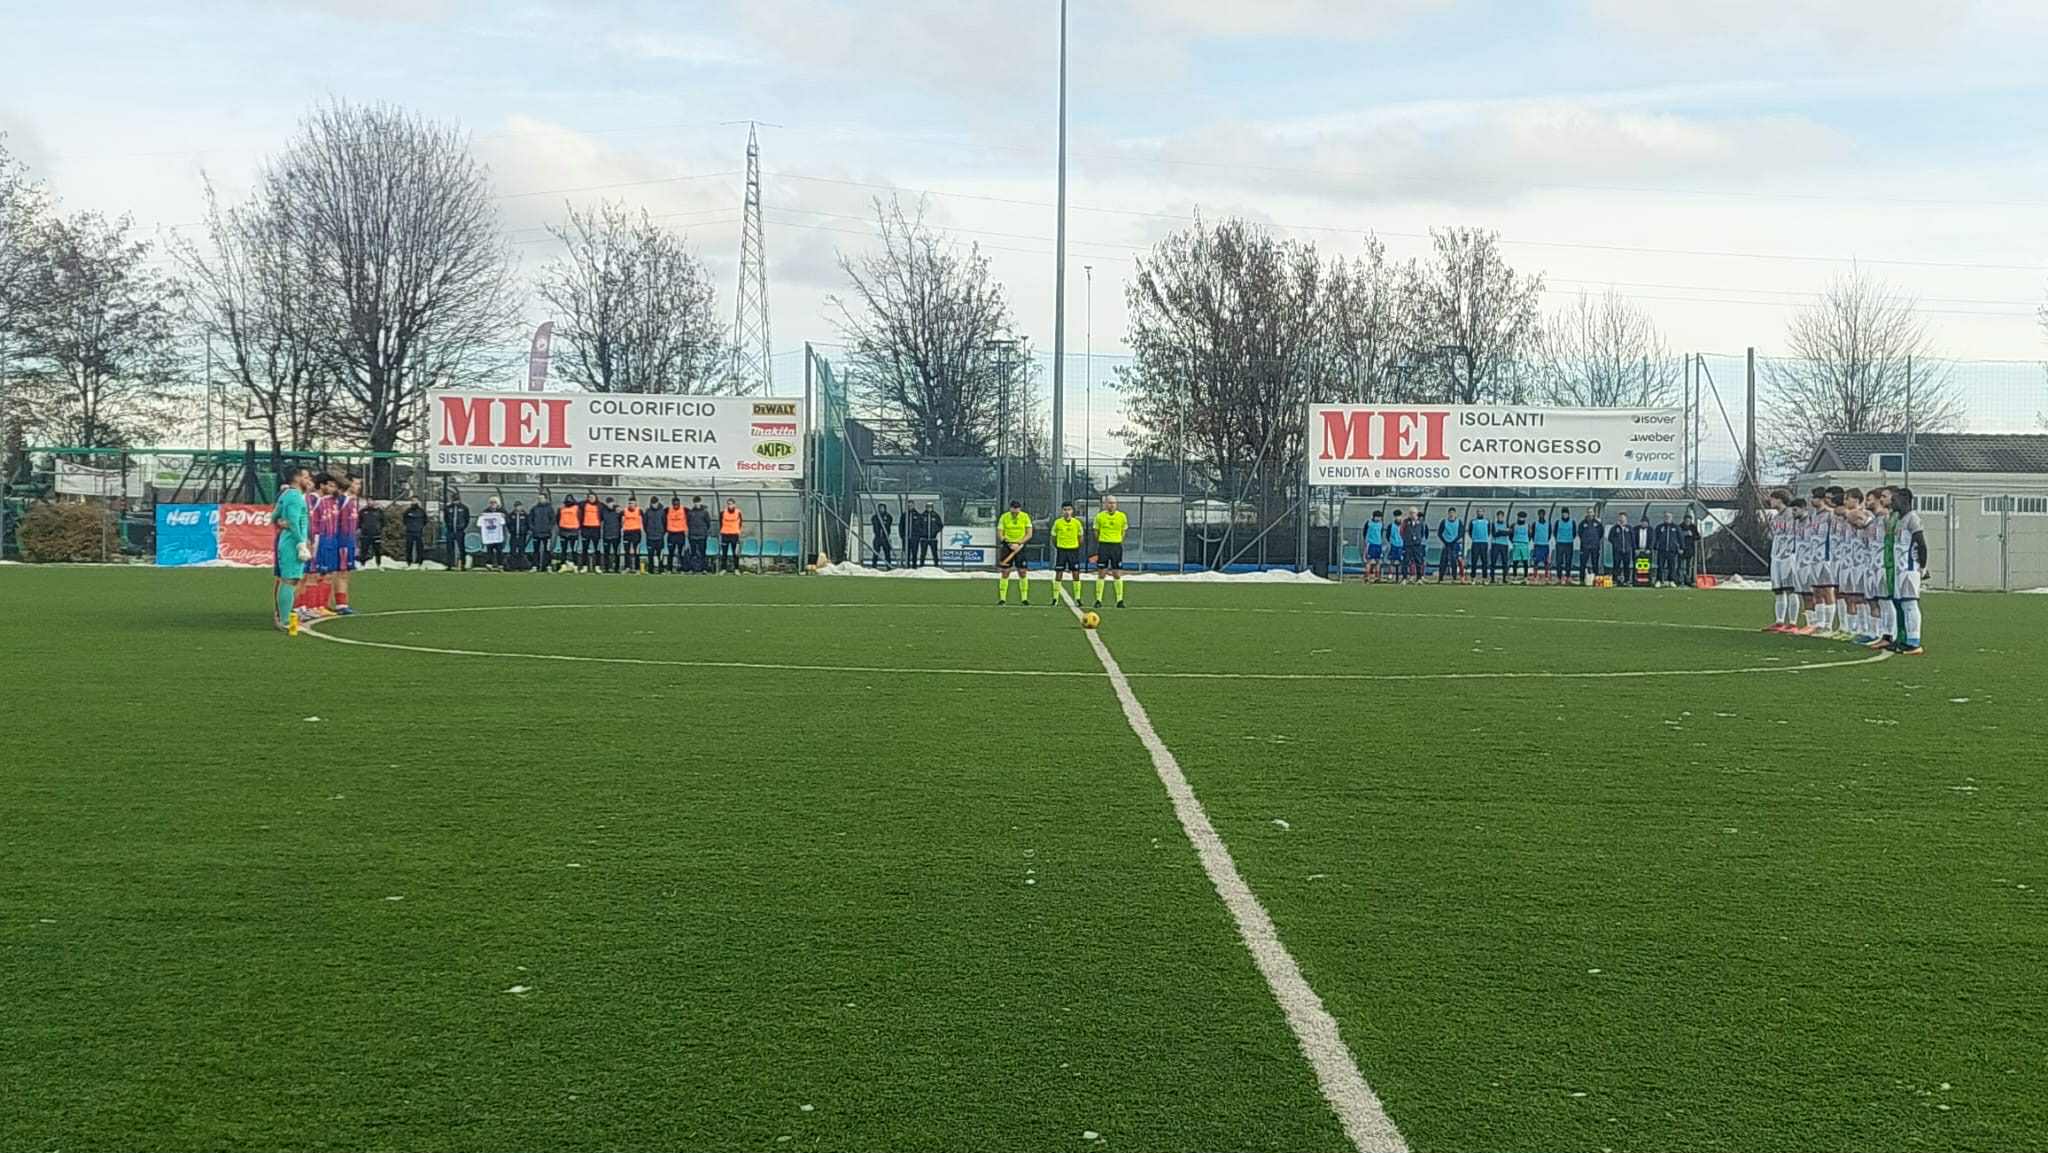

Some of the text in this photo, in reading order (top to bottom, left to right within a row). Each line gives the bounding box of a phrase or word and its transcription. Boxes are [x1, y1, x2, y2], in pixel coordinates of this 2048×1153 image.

[589, 400, 716, 417] COLORIFICIO
[438, 396, 573, 449] MEI
[1459, 412, 1545, 428] ISOLANTI
[1641, 415, 1677, 424] isover
[588, 427, 717, 444] UTENSILERIA
[1319, 410, 1451, 461] MEI
[1637, 432, 1676, 442] weber
[756, 443, 792, 457] AKIFIX
[1459, 438, 1602, 455] CARTONGESSO
[438, 452, 573, 467] SISTEMI COSTRUTTIVI
[588, 453, 721, 471] FERRAMENTA
[1635, 451, 1676, 462] gyproc
[736, 460, 777, 471] fischer
[1319, 466, 1451, 479] VENDITA e INGROSSO
[1459, 465, 1619, 482] CONTROSOFFITTI
[225, 510, 273, 526] BOVES
